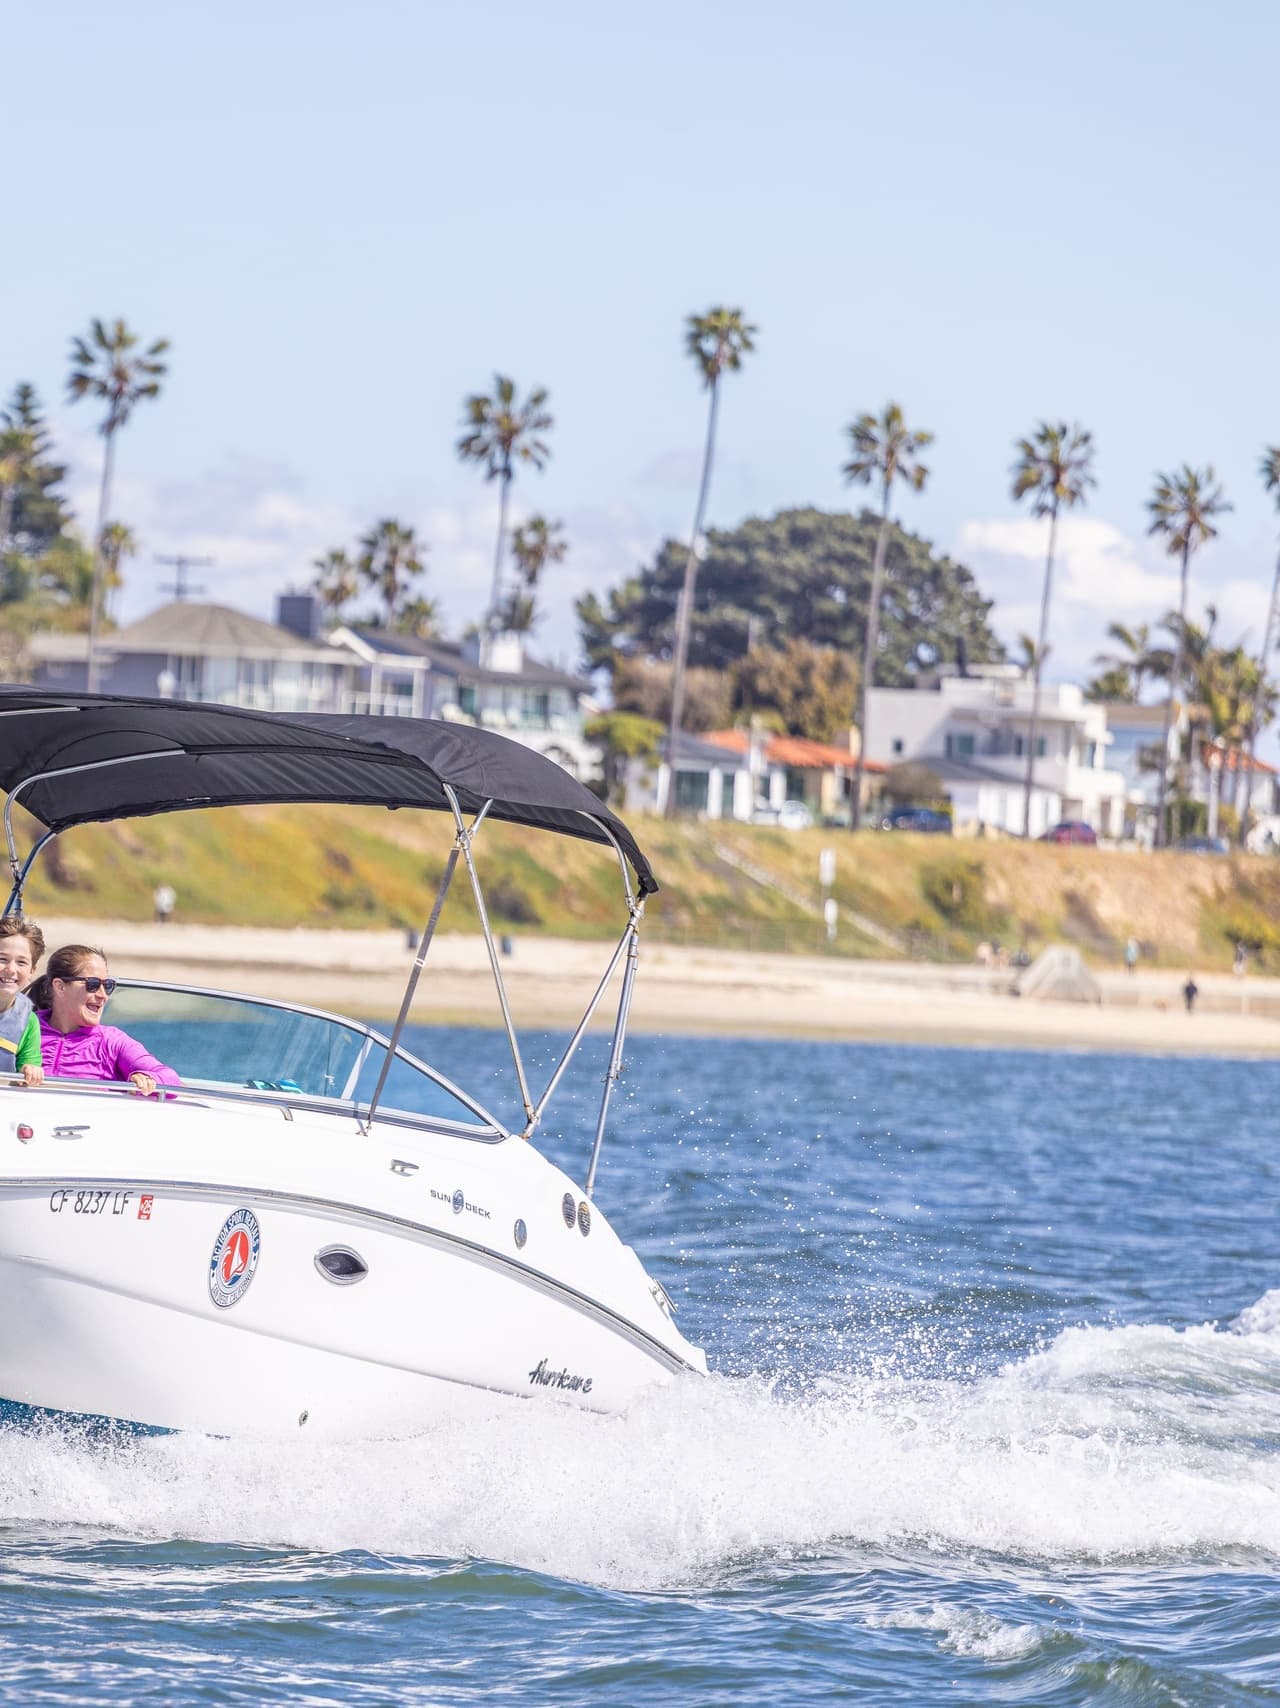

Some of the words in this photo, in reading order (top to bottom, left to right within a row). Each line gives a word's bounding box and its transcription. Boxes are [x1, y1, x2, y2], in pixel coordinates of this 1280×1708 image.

[50, 1189, 74, 1213] CF
[74, 1190, 112, 1214] 8237
[112, 1191, 135, 1215] LF
[430, 1189, 451, 1203] SUN
[465, 1202, 491, 1220] DECK
[213, 1226, 229, 1261] ACTION
[228, 1210, 245, 1230] SPORT
[245, 1210, 260, 1246] RENTALS
[528, 1357, 593, 1393] Hurricane
